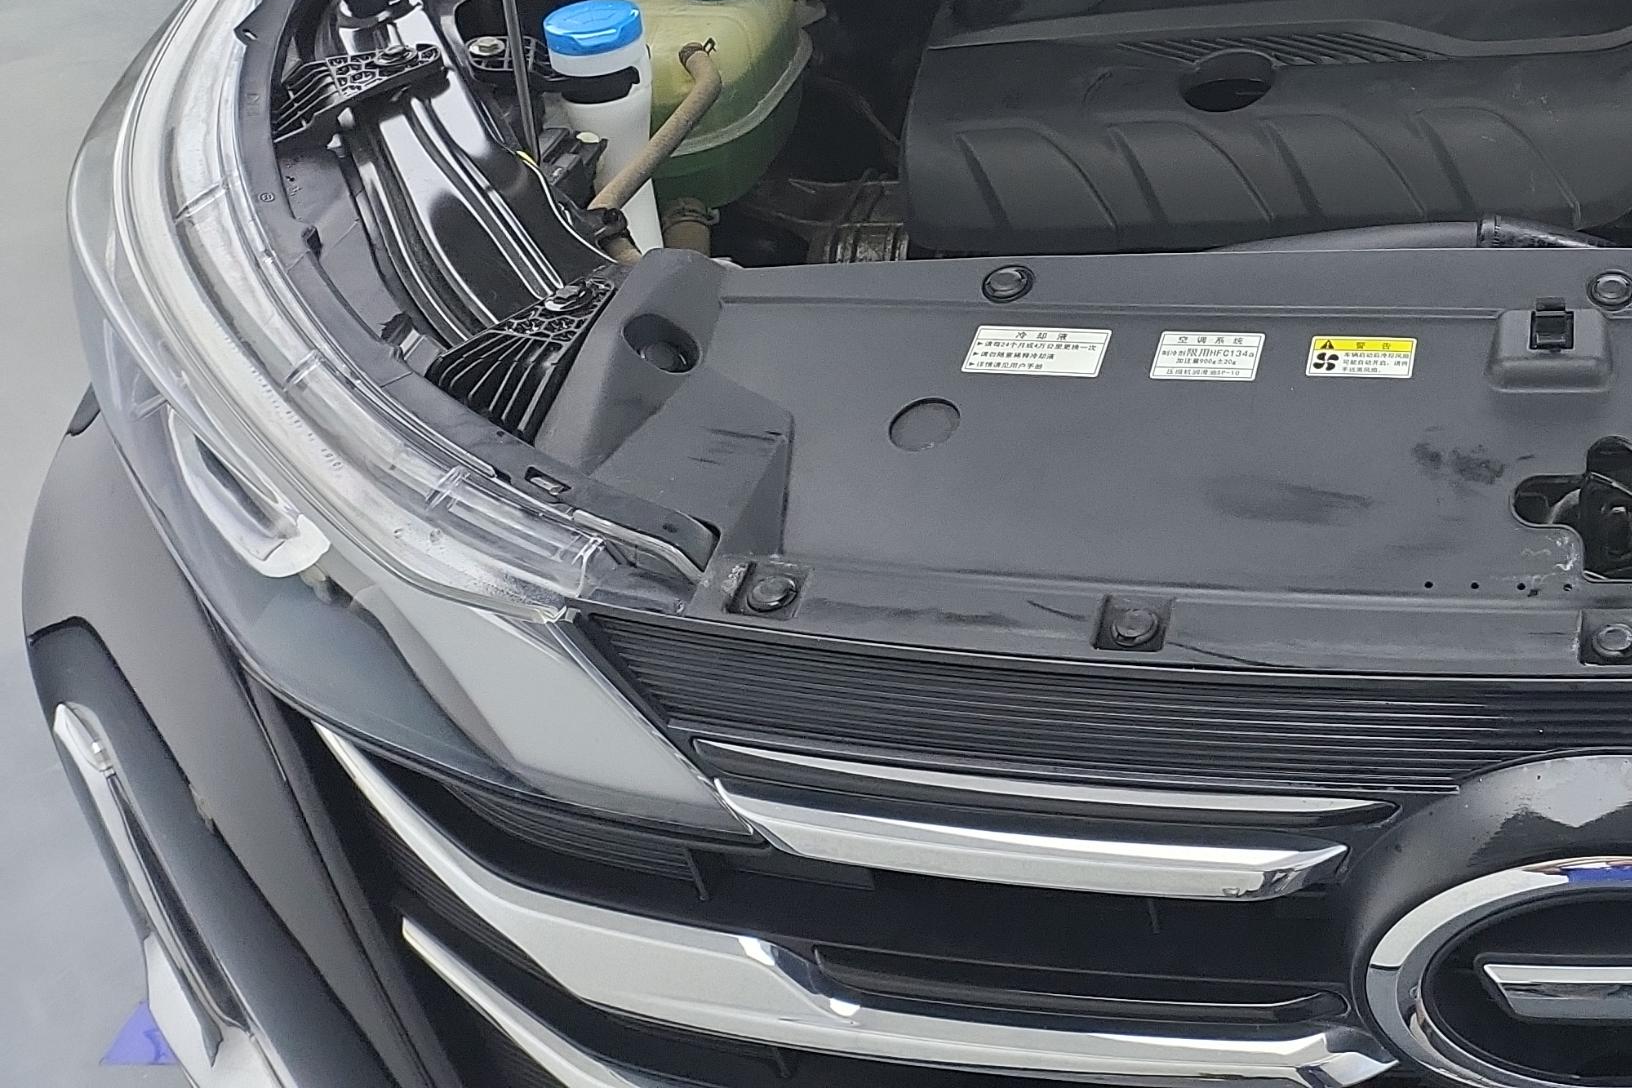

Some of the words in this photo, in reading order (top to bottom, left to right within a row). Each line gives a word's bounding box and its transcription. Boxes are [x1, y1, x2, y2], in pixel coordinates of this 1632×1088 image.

[1015, 331, 1069, 341] 冷却液
[1177, 336, 1244, 345] 空调系统
[1356, 341, 1391, 350] 警告
